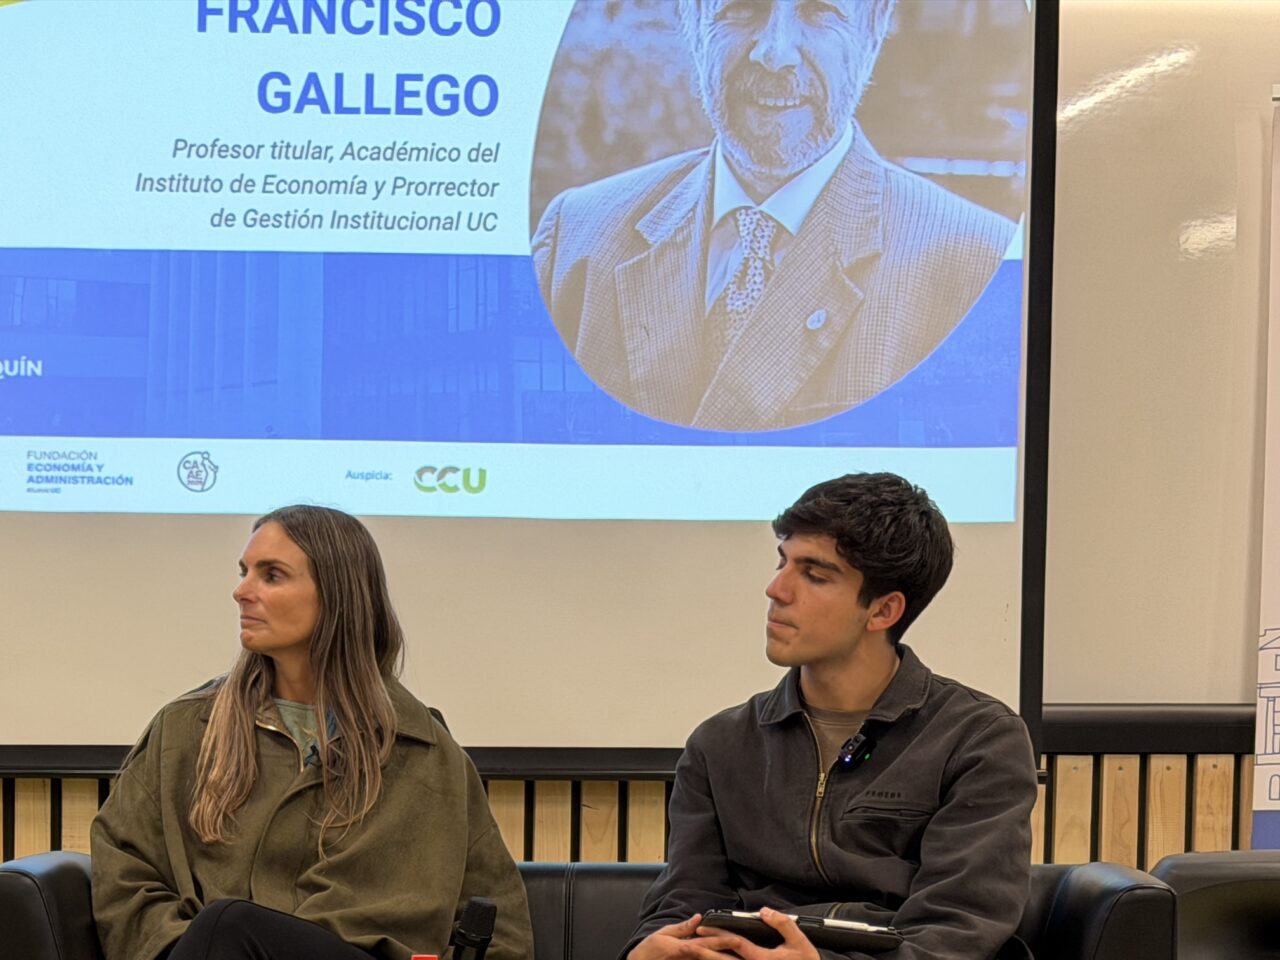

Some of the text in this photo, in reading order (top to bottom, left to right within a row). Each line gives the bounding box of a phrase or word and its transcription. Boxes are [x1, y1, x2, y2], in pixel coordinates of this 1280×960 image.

[196, 0, 501, 37] FRANCISCO
[257, 71, 500, 117] GALLEGO
[171, 138, 501, 164] Profesor titular, Académico del
[135, 173, 500, 200] Instituto de Economía y Prorrector
[210, 208, 499, 231] de Gestión Institucional UC
[26, 450, 98, 461] FUNDACIÓN
[26, 462, 105, 473] ECONOMÍA Y
[26, 474, 134, 486] ADMINISTRACIÓN
[345, 470, 393, 482] Auspicia:
[414, 465, 487, 494] CCU
